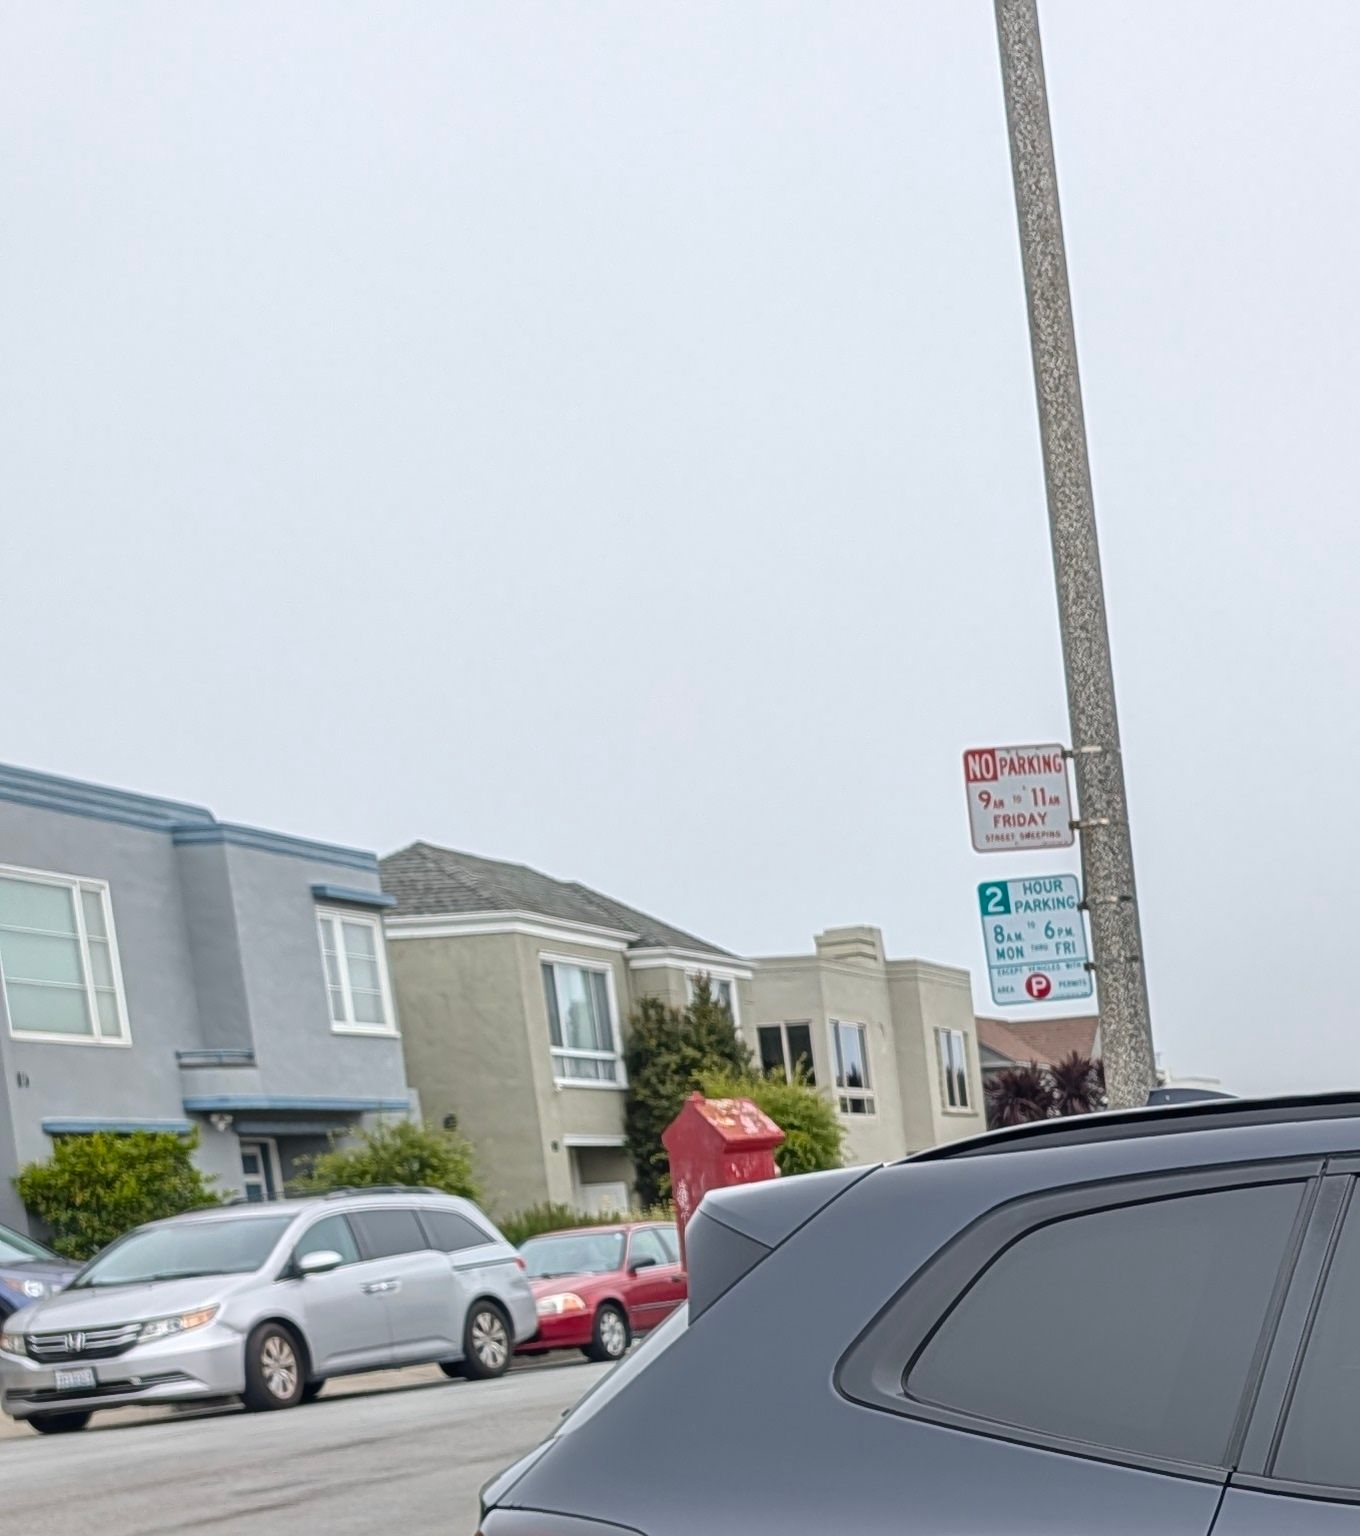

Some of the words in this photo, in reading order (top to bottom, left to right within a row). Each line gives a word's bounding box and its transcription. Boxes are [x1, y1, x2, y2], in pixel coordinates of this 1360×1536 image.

[968, 753, 992, 780] NO
[999, 753, 1062, 776] PARKING
[993, 812, 1047, 828] FRIDAY
[986, 832, 1014, 842] STREET
[985, 886, 1005, 913] 2
[1023, 880, 1063, 895] HOUR
[1015, 896, 1075, 913] PARKING
[996, 946, 1024, 960] MON
[1055, 941, 1076, 955] FRI
[998, 985, 1015, 994] AREA
